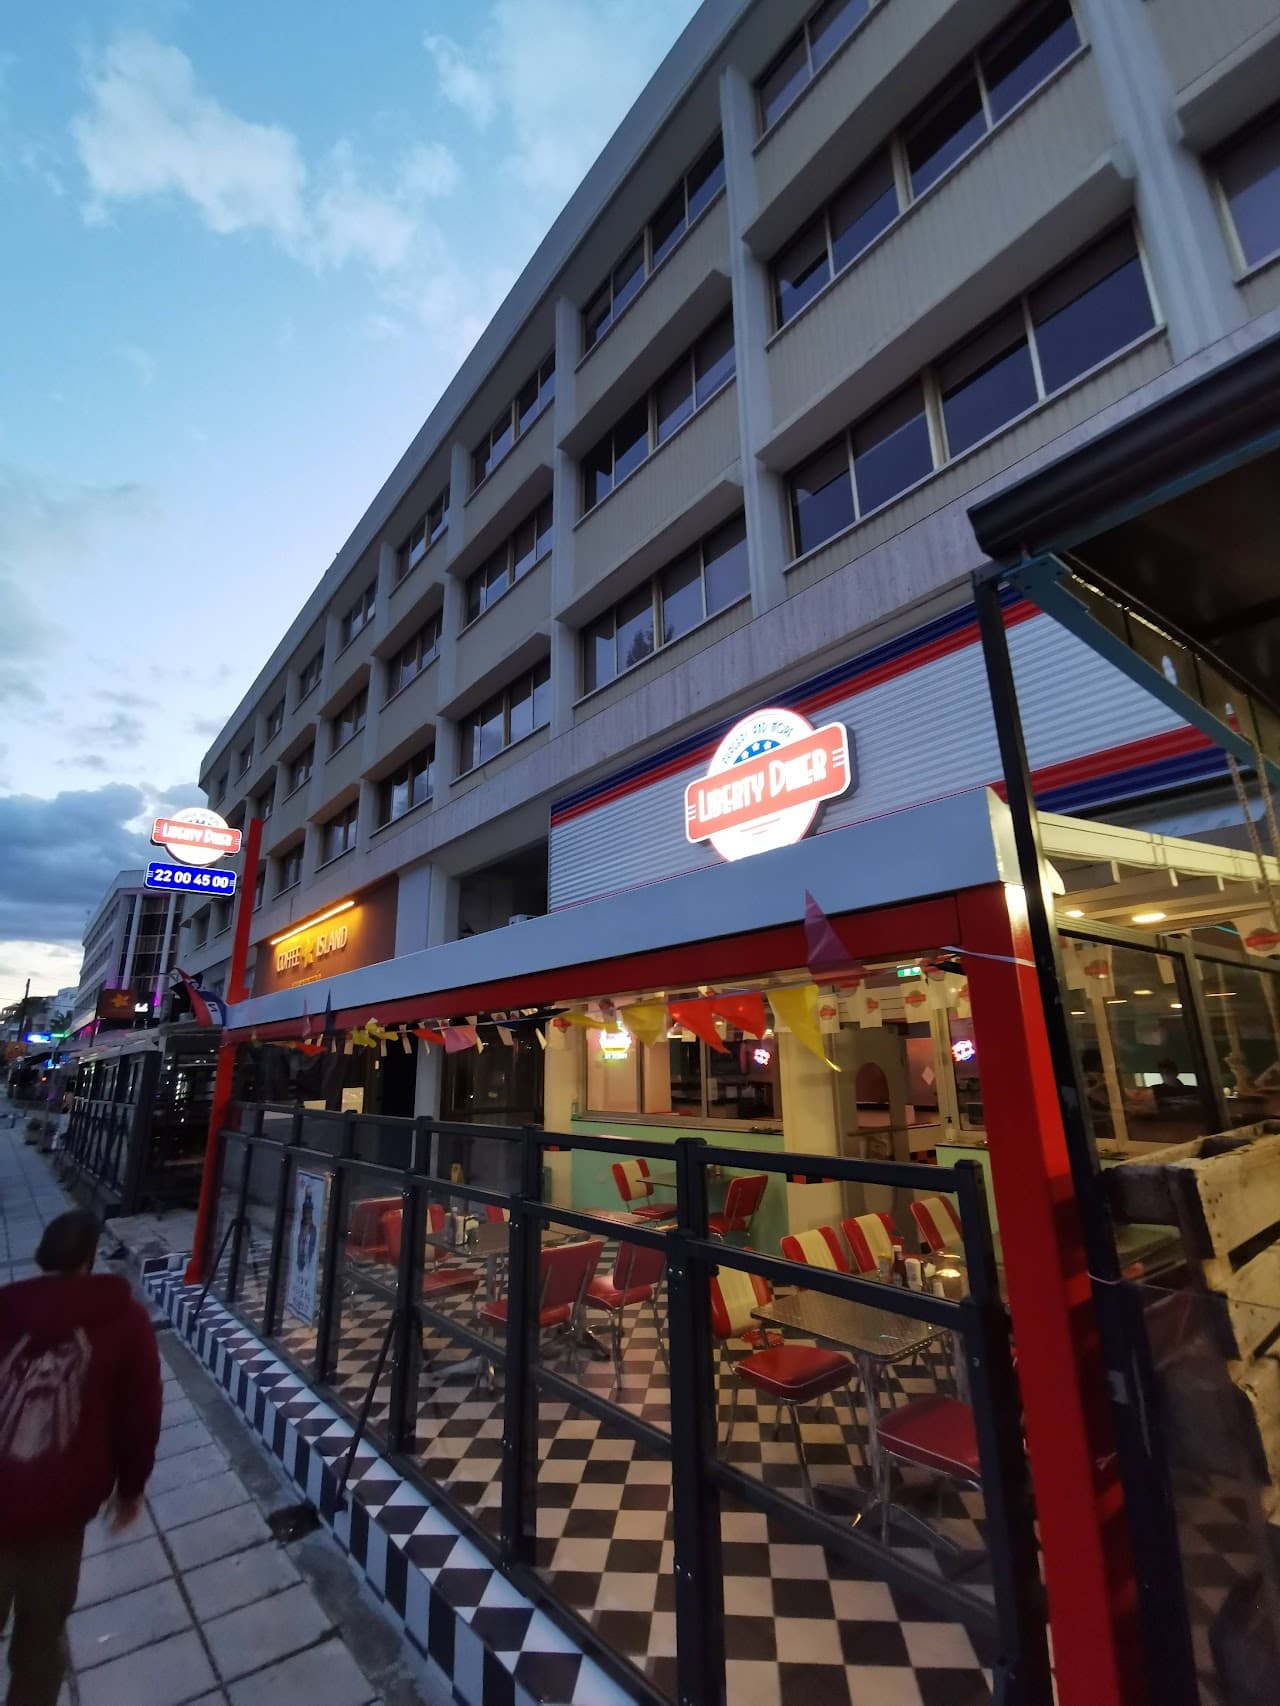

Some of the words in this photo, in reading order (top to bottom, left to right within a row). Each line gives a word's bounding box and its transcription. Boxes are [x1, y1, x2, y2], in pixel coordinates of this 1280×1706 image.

[698, 771, 765, 823] LIBERTY
[769, 748, 828, 798] DINER
[154, 868, 172, 882] 22
[174, 871, 192, 884] 00
[193, 873, 211, 886] 45
[212, 875, 229, 889] 00
[276, 945, 301, 972] COFFEE
[316, 926, 348, 957] ISLAND
